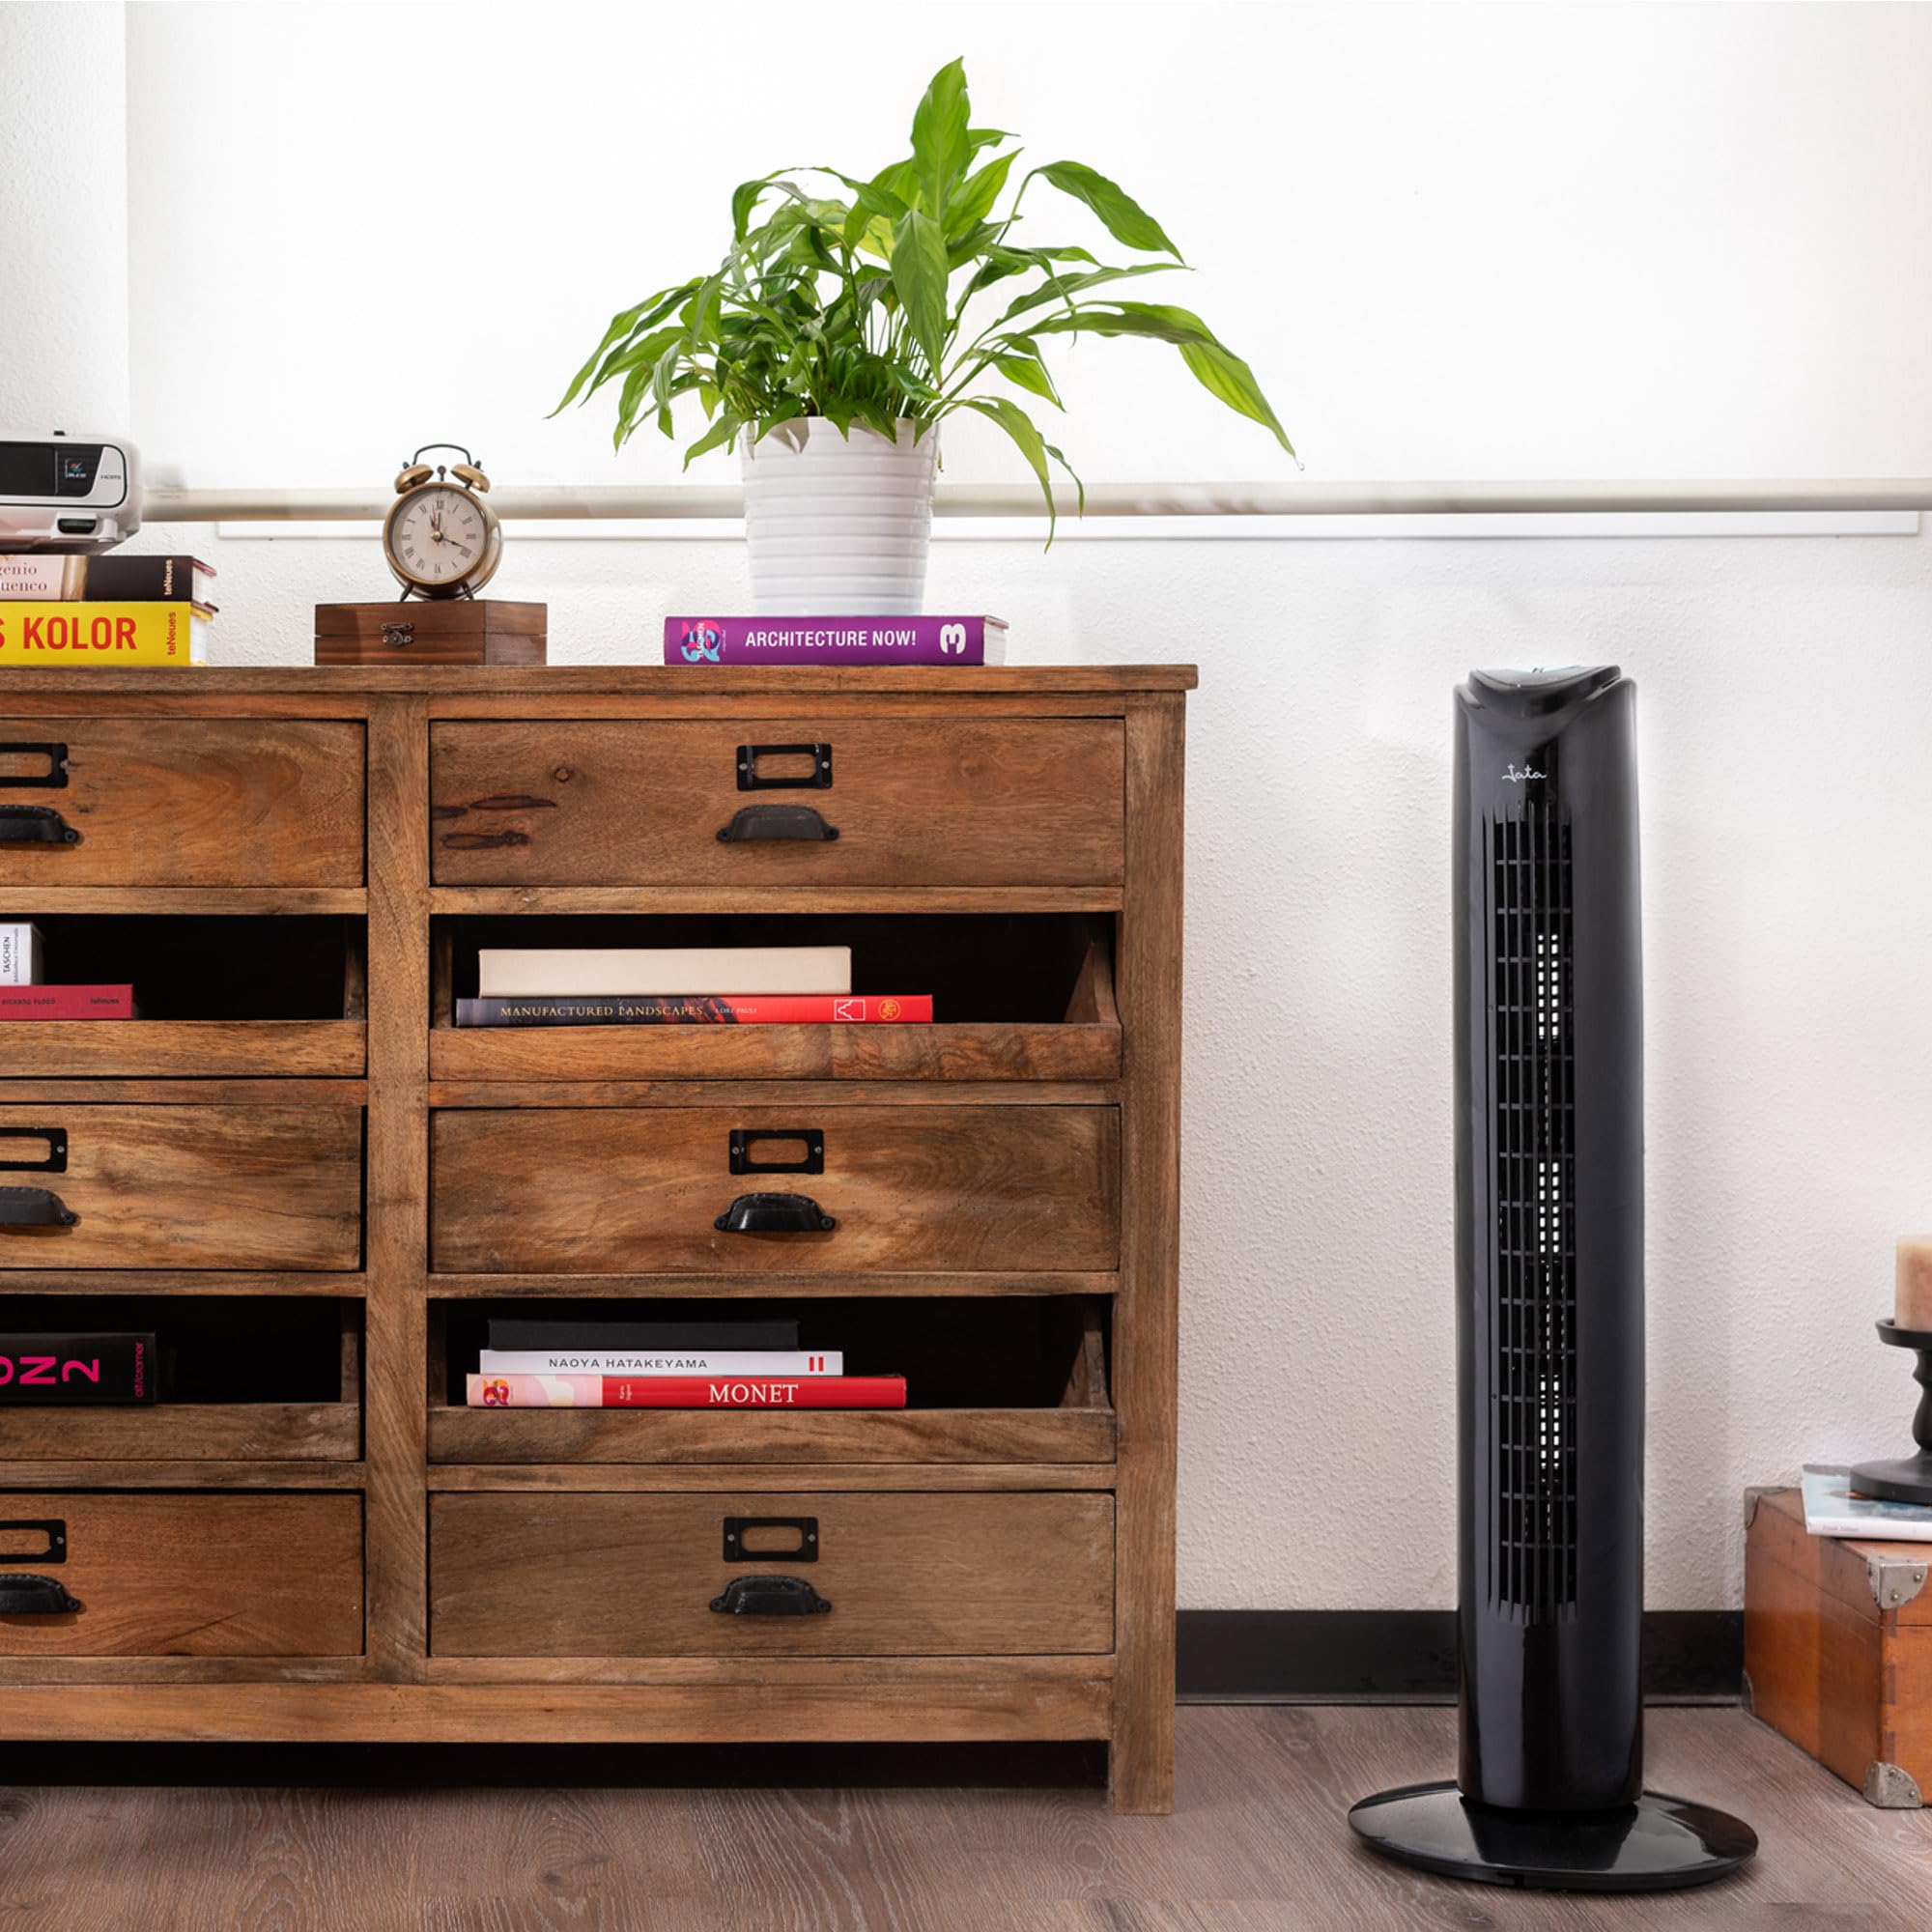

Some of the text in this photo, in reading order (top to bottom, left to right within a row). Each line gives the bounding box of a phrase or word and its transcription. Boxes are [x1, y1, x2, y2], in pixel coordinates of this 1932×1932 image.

[163, 558, 173, 596] teNeues
[23, 616, 137, 650] KOLOR
[166, 611, 177, 656] teNeues
[745, 630, 867, 648] ARCHITECTURE
[872, 630, 917, 647] NOW!
[1501, 763, 1548, 782] Jata
[499, 1006, 703, 1017] MANUFACTURED LANDSCAPES
[549, 1358, 708, 1369] NAOYA HATAKEYAMA
[709, 1383, 800, 1404] MONET
